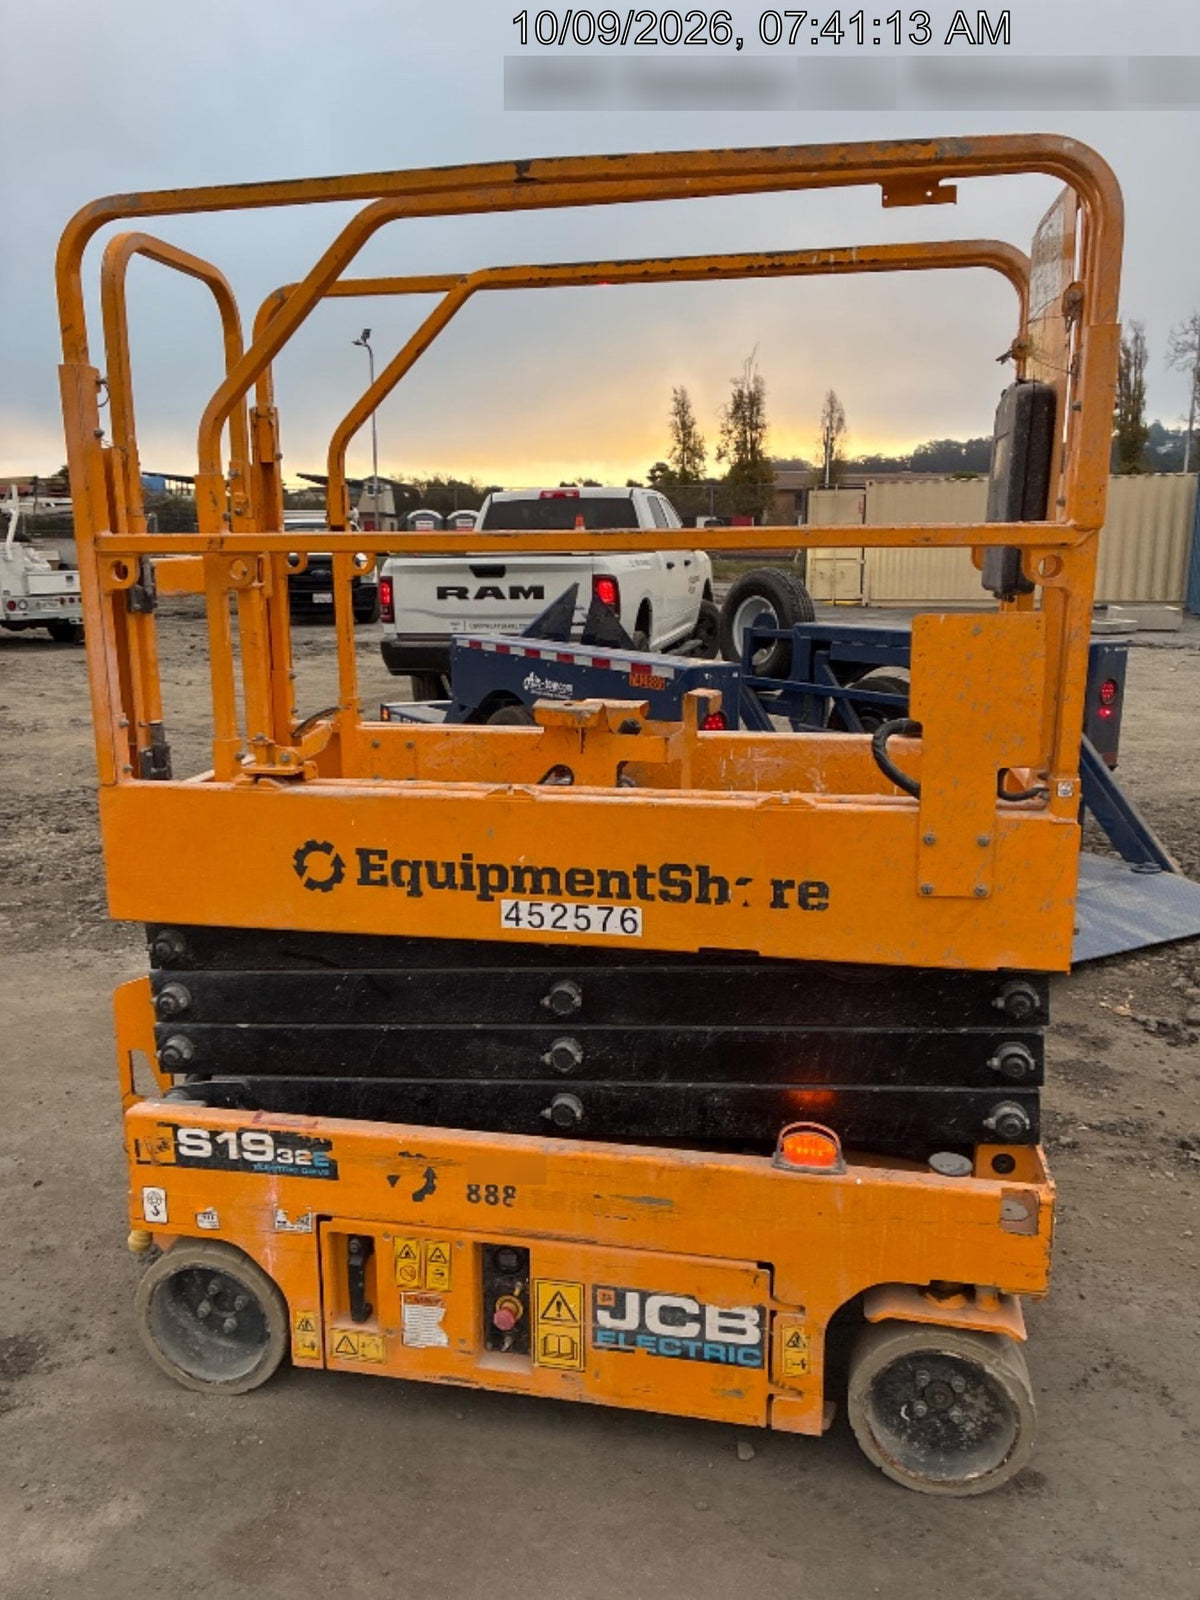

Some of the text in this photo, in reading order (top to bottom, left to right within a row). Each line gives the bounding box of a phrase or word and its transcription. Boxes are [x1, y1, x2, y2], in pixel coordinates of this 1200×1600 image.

[437, 586, 545, 600] RAM
[504, 902, 638, 934] 452576
[597, 1291, 760, 1345] JCB
[596, 1330, 762, 1367] ELECTRIC
